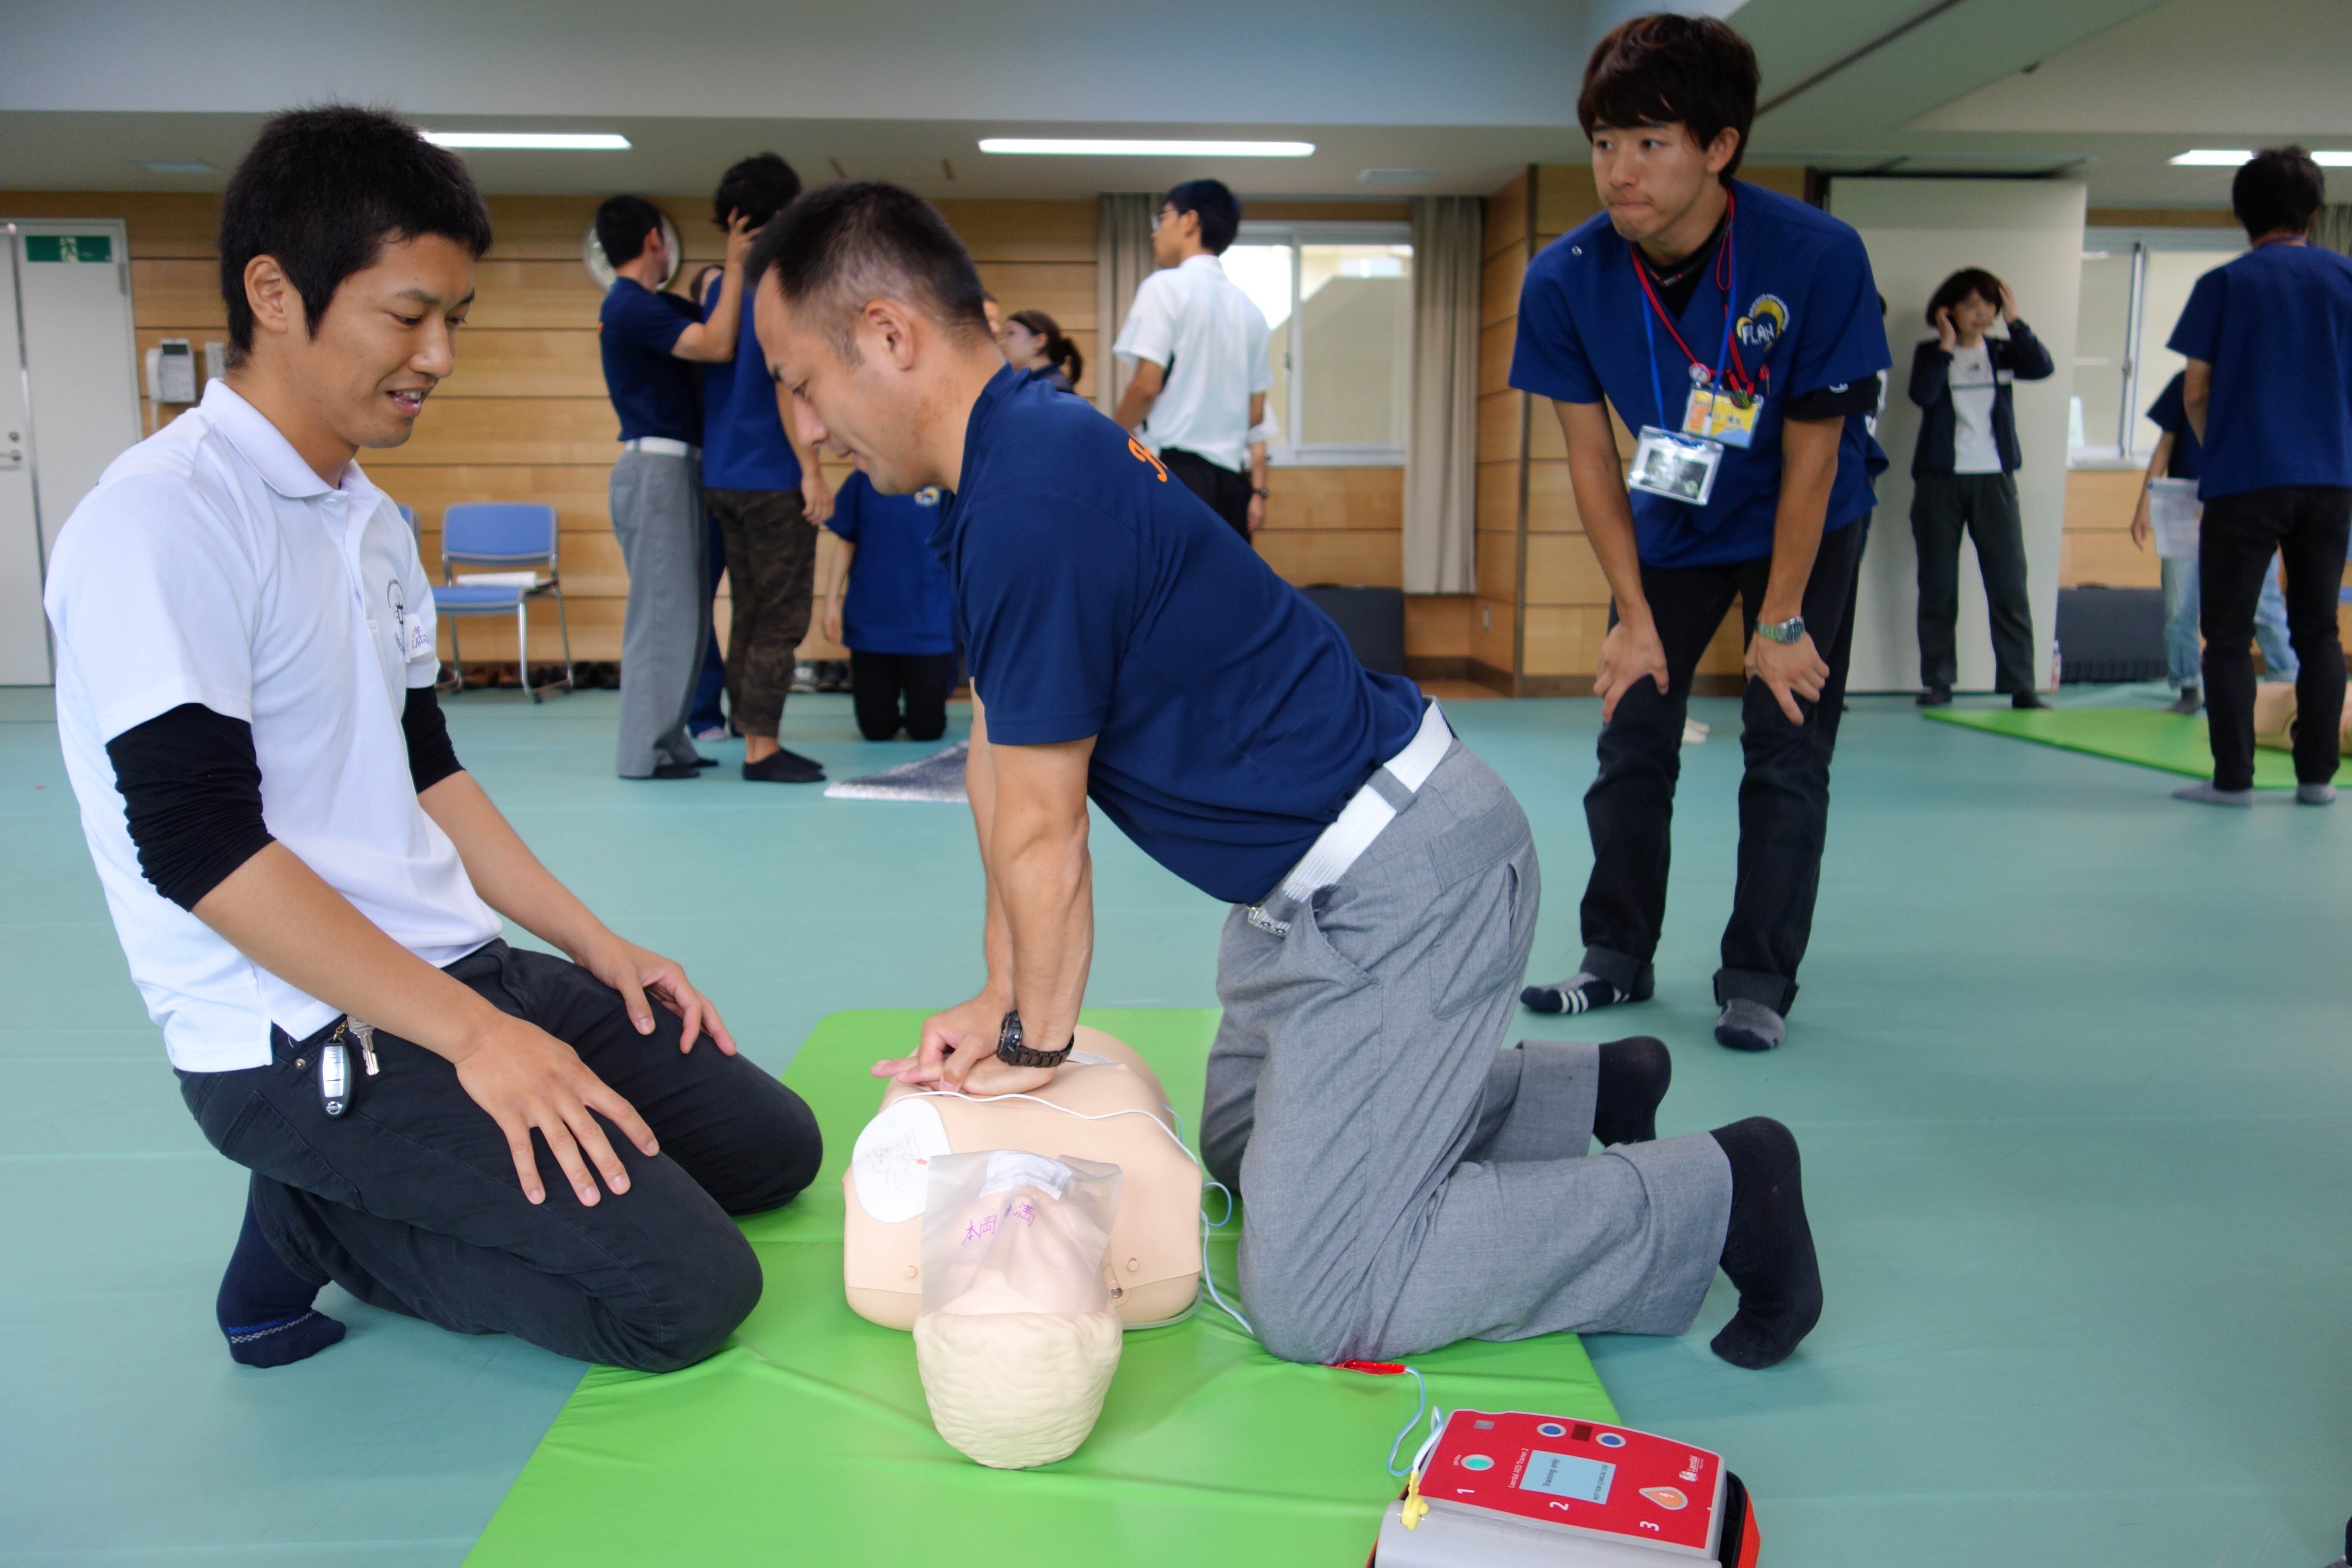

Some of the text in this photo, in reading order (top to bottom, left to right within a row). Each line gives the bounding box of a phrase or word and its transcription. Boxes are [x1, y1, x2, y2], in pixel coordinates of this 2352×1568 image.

[1516, 1451, 1527, 1464] Trainer
[1513, 1465, 1522, 1473] AED
[1542, 1458, 1561, 1486] Training only
[1597, 1471, 1607, 1485] CLINICAL
[1550, 1501, 1568, 1510] 2
[1639, 1521, 1659, 1531] 3
